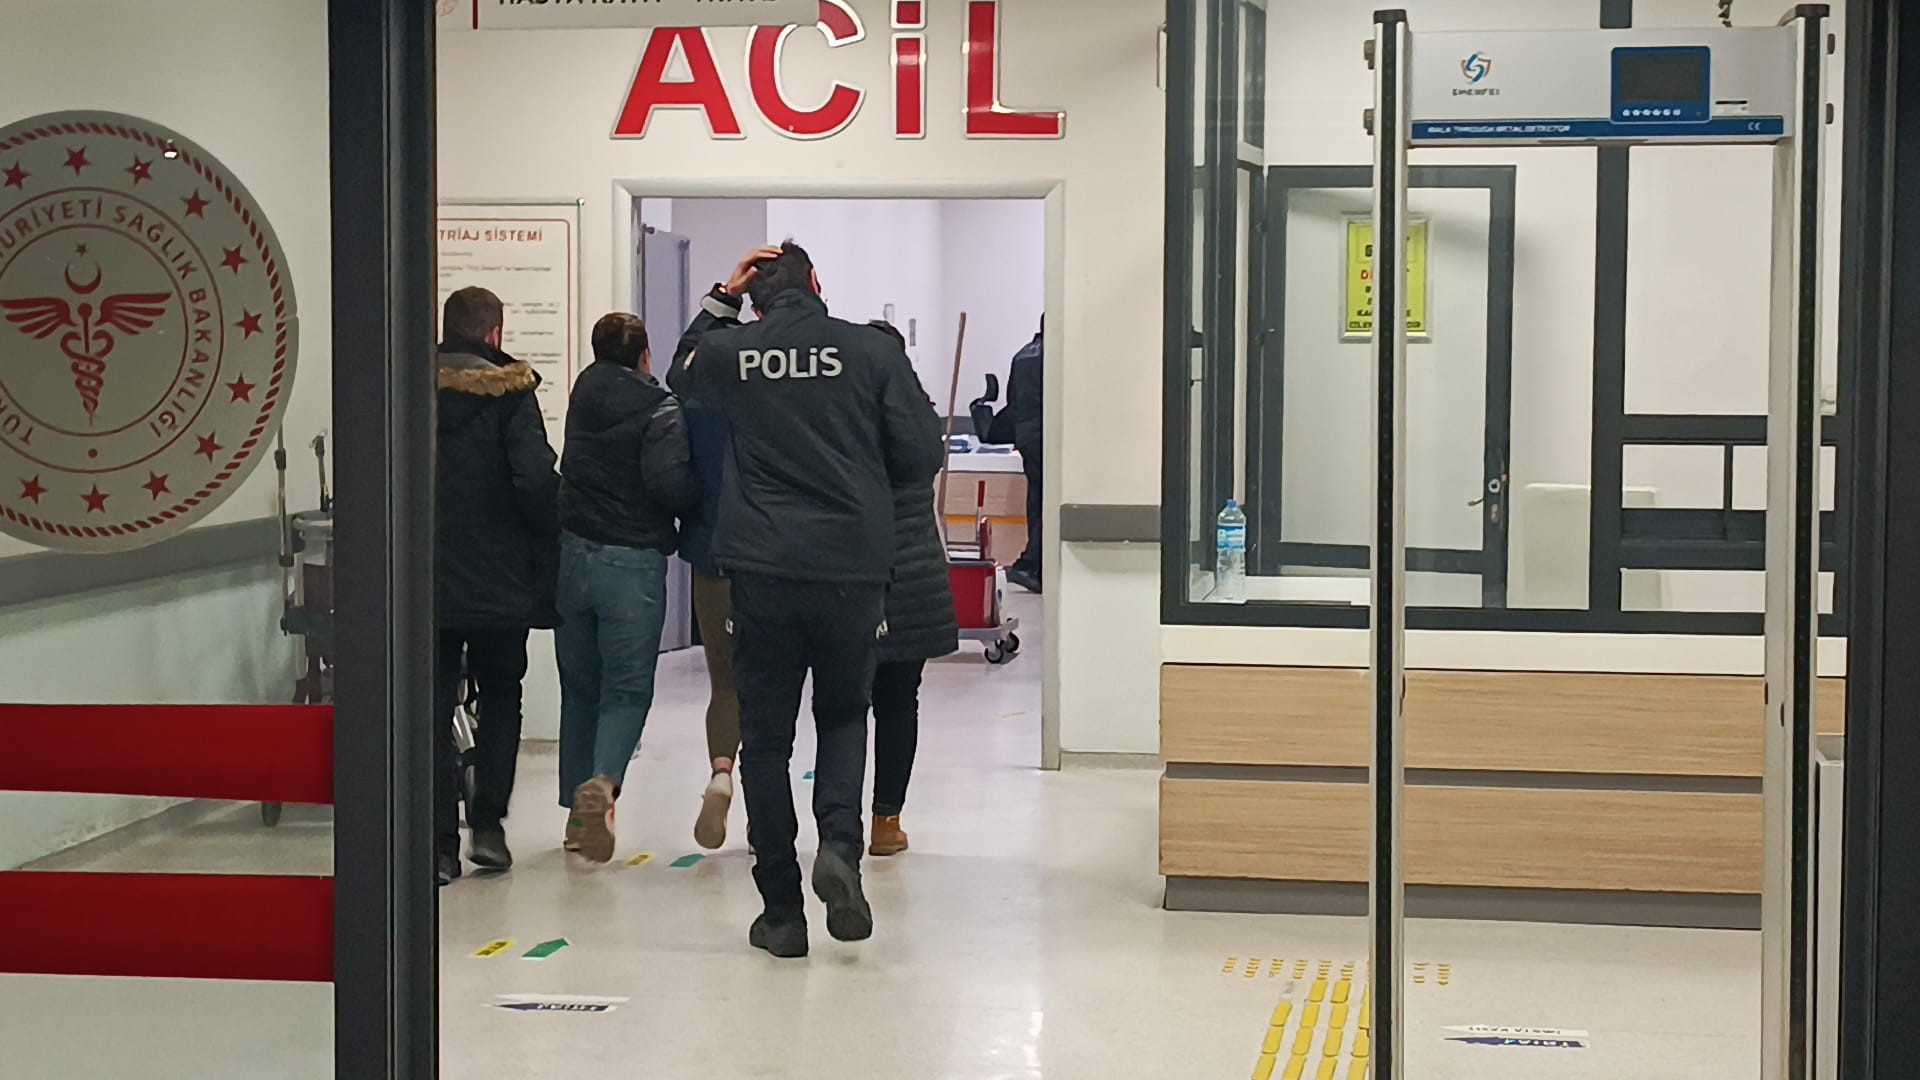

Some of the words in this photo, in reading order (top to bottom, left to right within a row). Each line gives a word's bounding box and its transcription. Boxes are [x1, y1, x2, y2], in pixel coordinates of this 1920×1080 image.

[112, 205, 197, 280] SAĞLIK
[484, 226, 543, 242] SİSTEMİ
[150, 288, 212, 438] BAKANLIĞI
